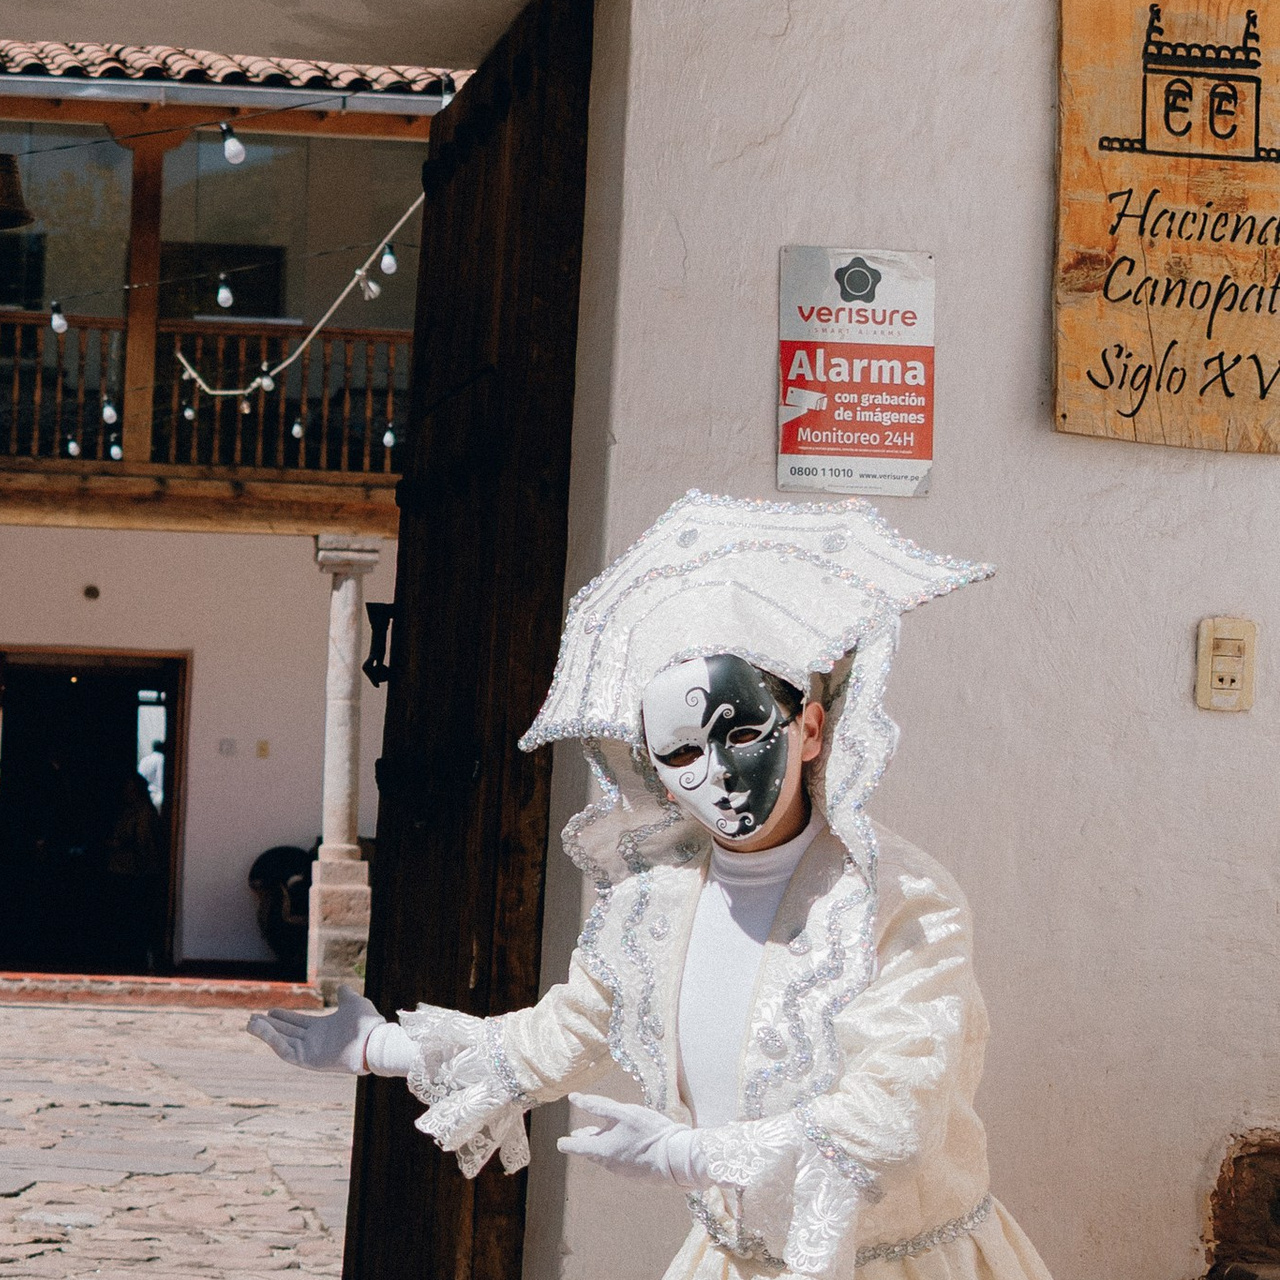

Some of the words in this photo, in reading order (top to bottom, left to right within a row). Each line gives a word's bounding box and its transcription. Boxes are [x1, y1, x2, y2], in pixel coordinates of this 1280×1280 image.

[797, 305, 918, 327] verisure
[787, 348, 926, 386] Alarma
[1086, 339, 1187, 418] Siglo
[834, 392, 858, 403] con
[860, 391, 925, 407] grabación
[834, 406, 853, 421] de
[856, 406, 925, 426] imágenes
[797, 427, 880, 445] Monitoreo
[884, 431, 914, 447] 24H
[789, 466, 818, 477] 0800
[858, 472, 920, 482] www.verisure.pe
